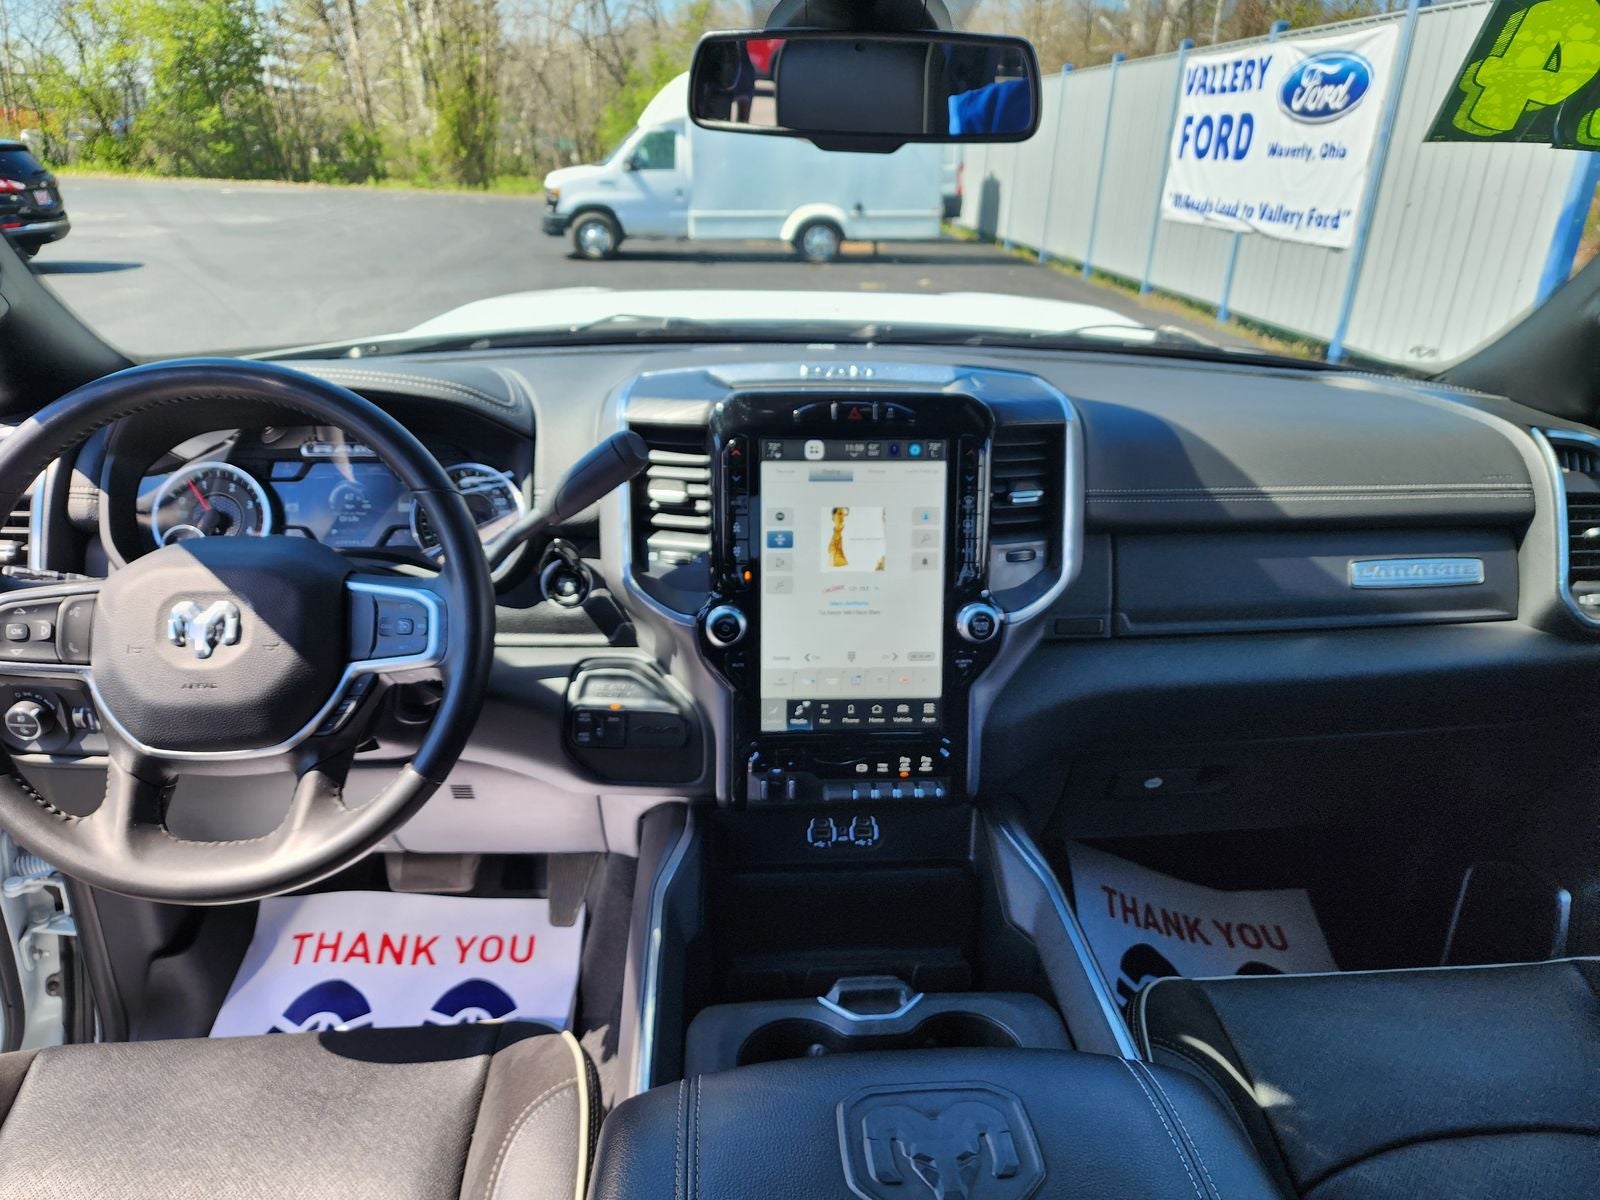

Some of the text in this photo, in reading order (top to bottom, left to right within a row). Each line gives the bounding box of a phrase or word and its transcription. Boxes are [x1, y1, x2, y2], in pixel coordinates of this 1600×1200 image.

[1186, 55, 1272, 95] VALLERY
[1291, 63, 1356, 112] Ford
[1178, 112, 1254, 160] FORD
[1267, 141, 1347, 162] Waverly, Ohio
[1259, 201, 1304, 230] Vallery
[1306, 206, 1351, 229] Ford"
[1101, 885, 1289, 952] THANK YOU
[292, 931, 536, 966] THANK YOU
